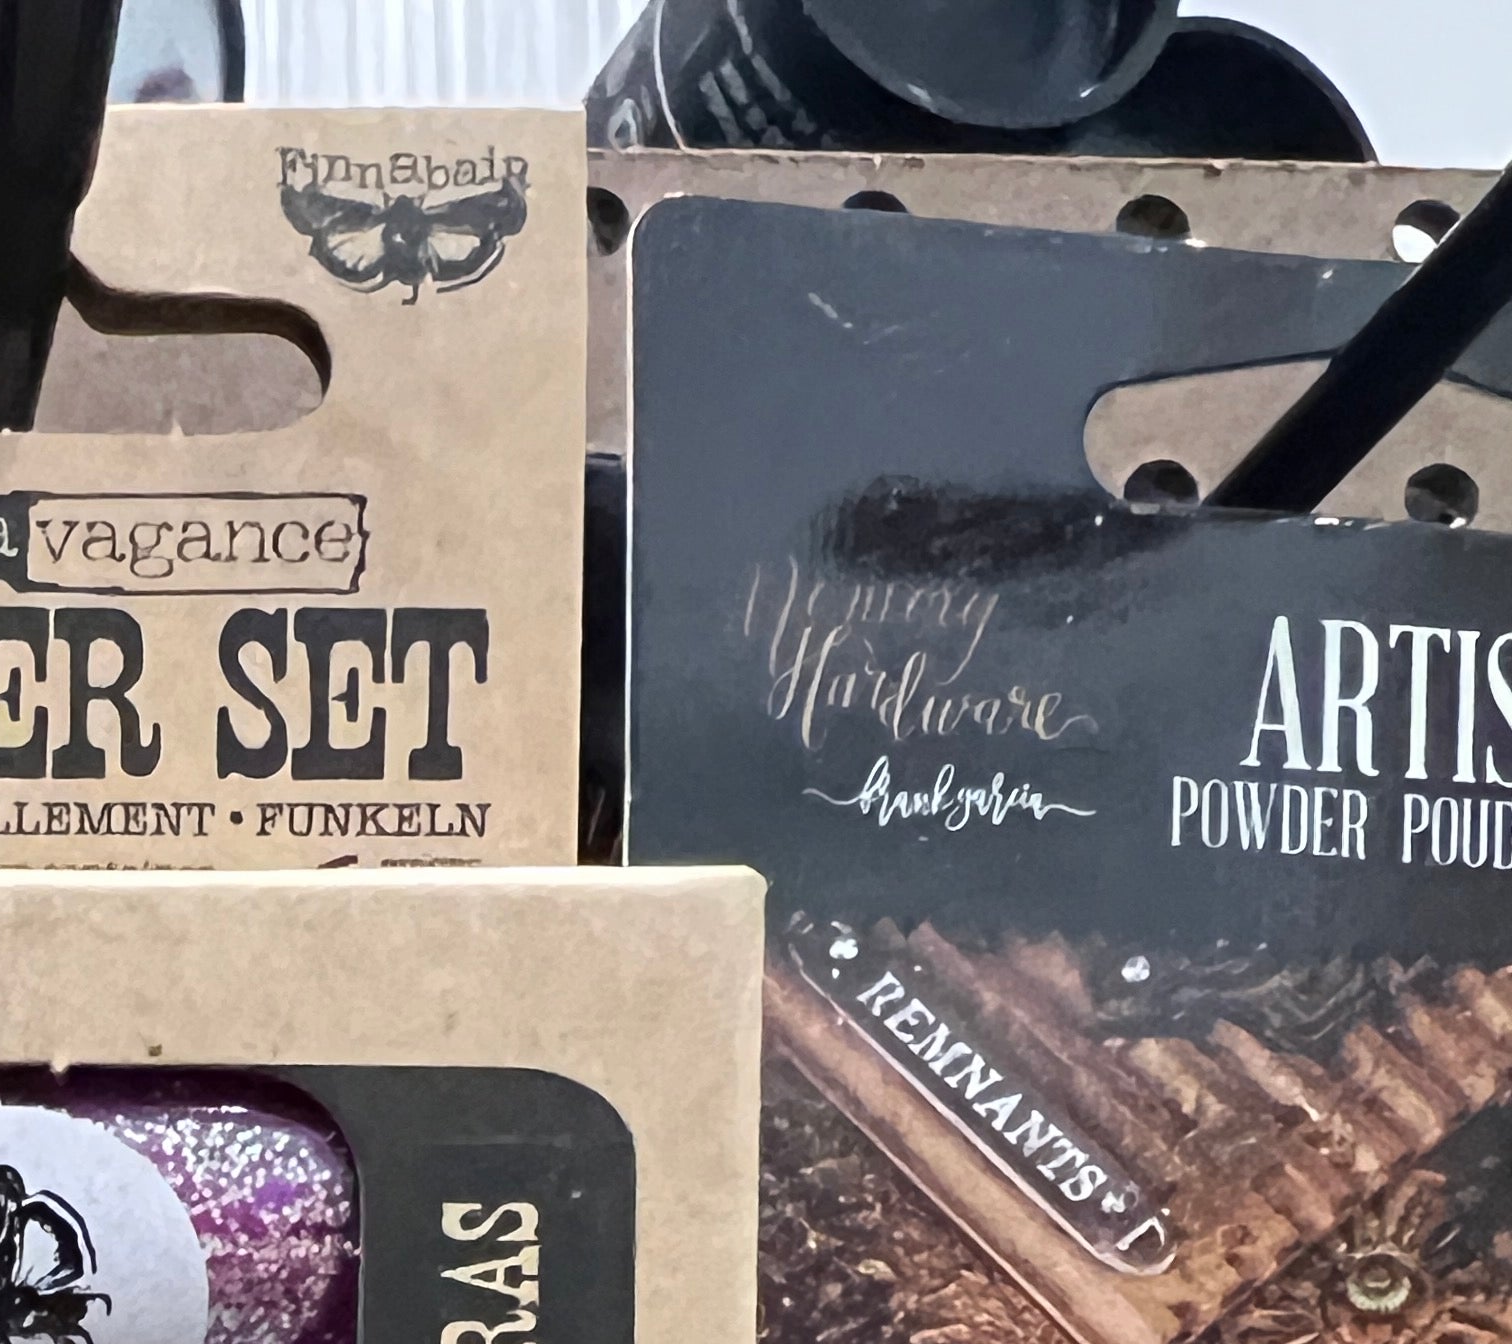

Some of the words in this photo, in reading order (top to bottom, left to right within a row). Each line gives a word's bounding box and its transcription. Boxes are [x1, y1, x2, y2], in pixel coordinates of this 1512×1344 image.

[215, 607, 488, 781] SET
[254, 801, 489, 839] FUNKELN
[1171, 775, 1369, 861] POWDER
[856, 971, 1107, 1201] REMNANTS
